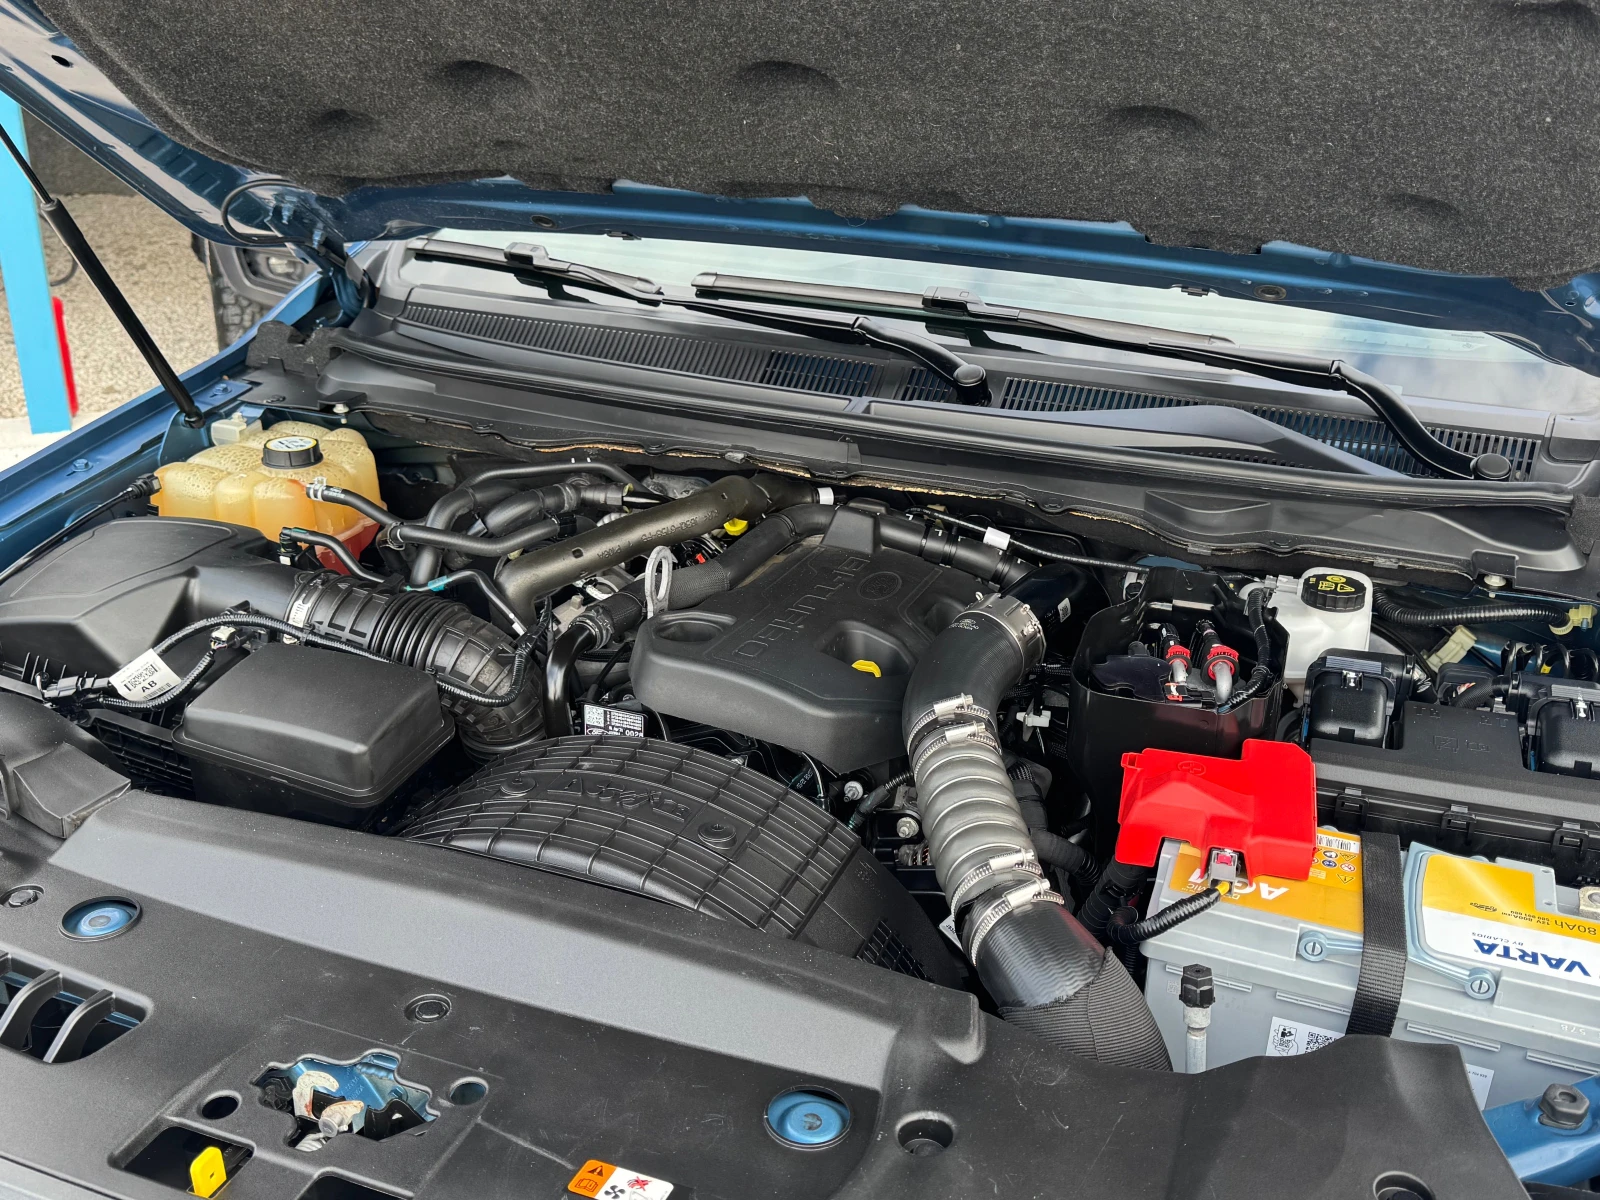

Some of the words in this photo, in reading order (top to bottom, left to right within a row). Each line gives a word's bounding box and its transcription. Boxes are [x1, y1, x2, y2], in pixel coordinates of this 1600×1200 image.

[141, 680, 157, 693] AB
[1554, 919, 1597, 936] 80Ah
[1473, 939, 1592, 977] VARTA
